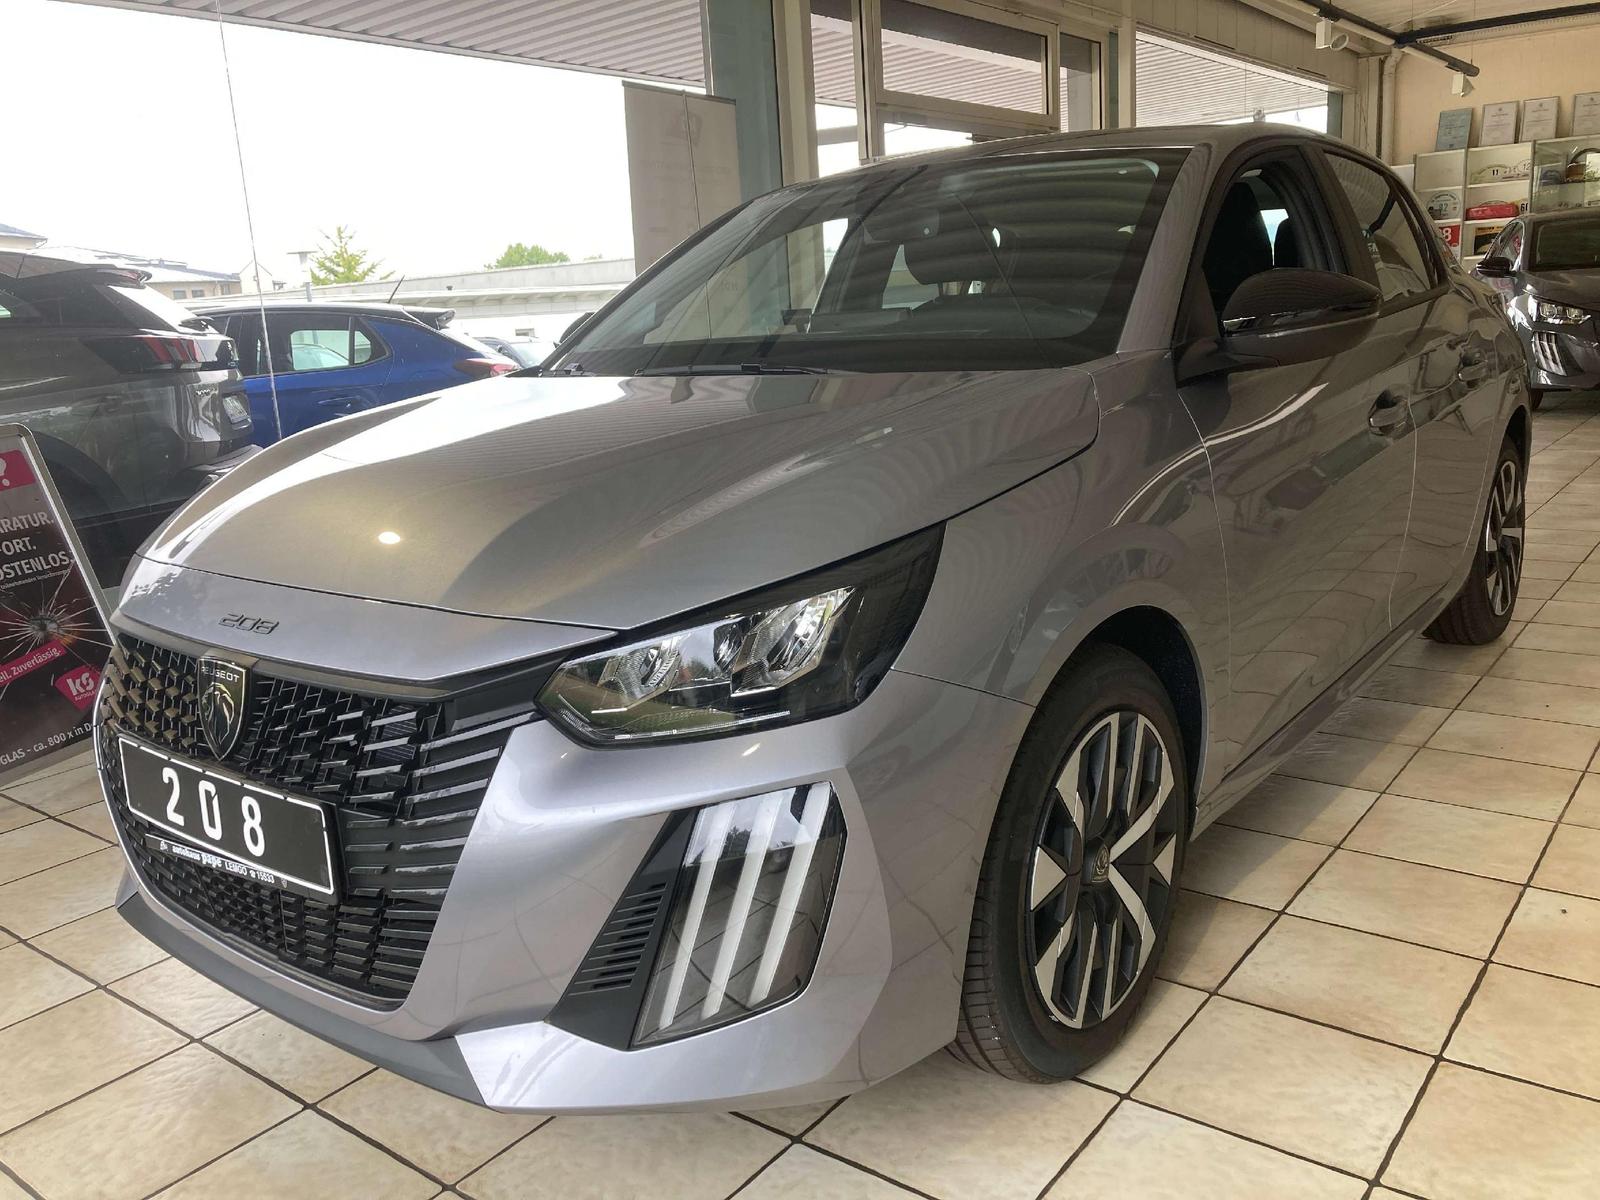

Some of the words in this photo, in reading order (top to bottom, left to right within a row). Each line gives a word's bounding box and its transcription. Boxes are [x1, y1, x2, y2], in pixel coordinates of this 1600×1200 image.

[0, 537, 37, 556] ORT.
[218, 613, 280, 635] 208
[11, 647, 62, 676] Zuverlässig.
[201, 666, 240, 683] PEUGEOT
[33, 742, 47, 753] ca.
[47, 732, 67, 746] 800
[67, 730, 74, 739] x
[74, 725, 84, 736] in
